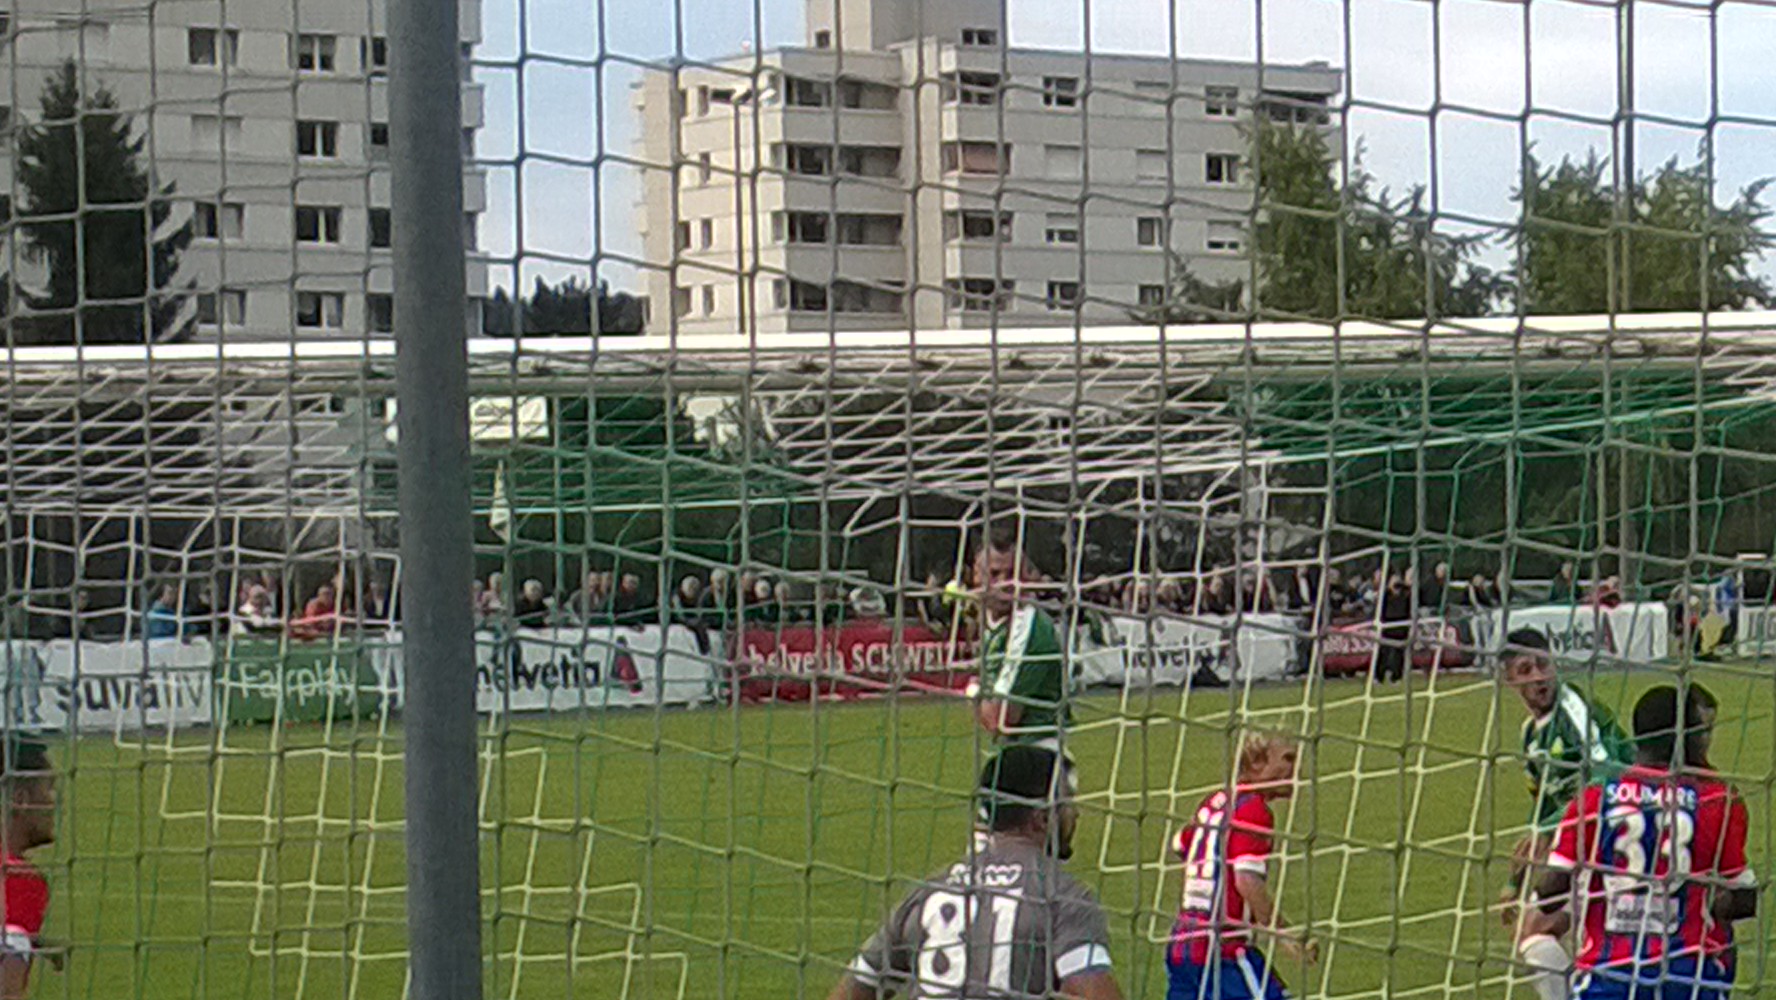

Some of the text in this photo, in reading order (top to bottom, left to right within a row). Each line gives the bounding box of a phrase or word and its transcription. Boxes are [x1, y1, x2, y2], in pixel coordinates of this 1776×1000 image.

[747, 643, 846, 677] helveia
[1604, 806, 1694, 892] 33
[917, 888, 1024, 994] 81
